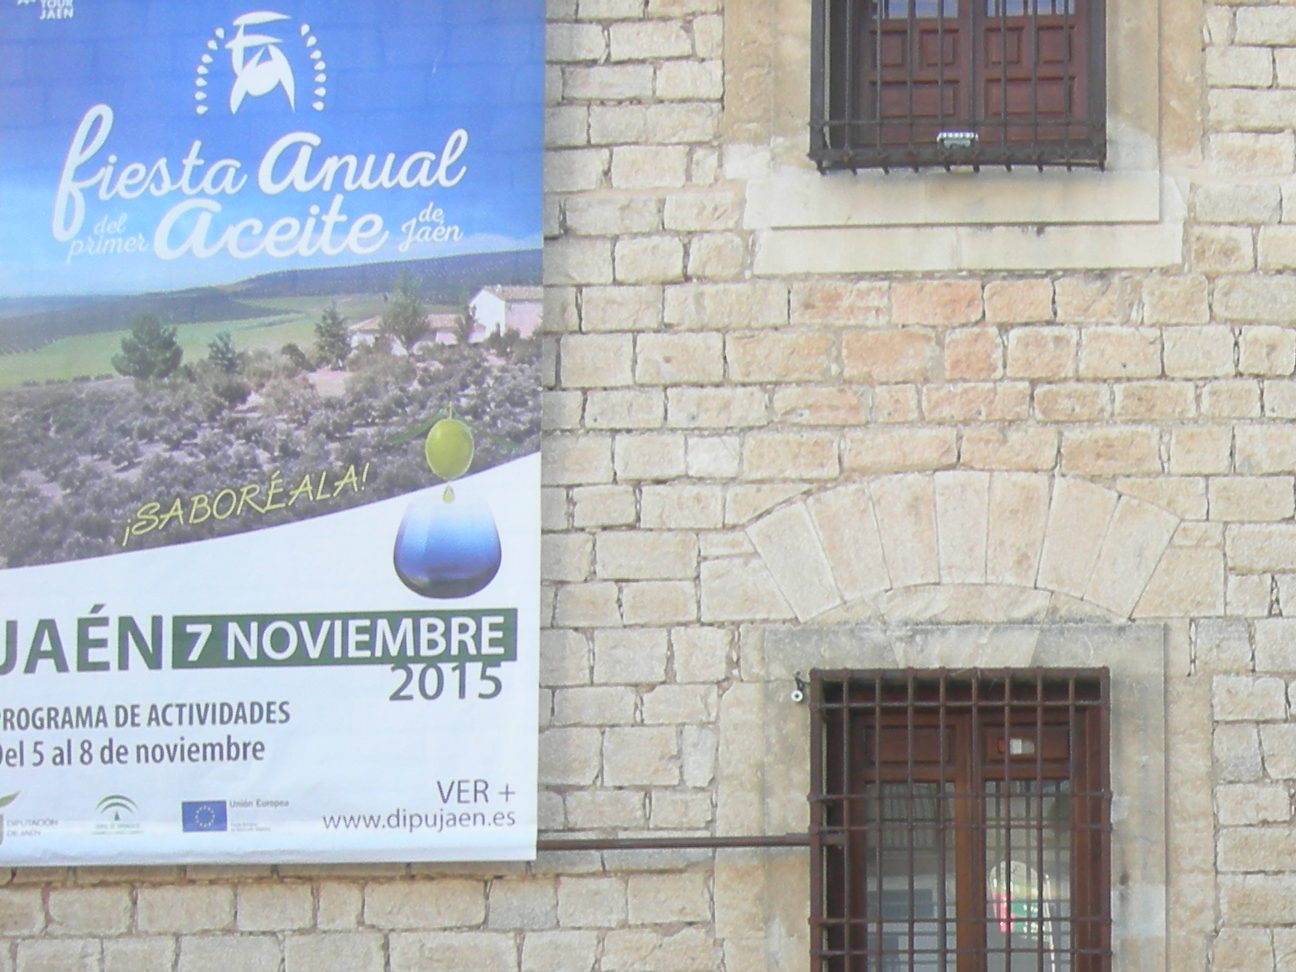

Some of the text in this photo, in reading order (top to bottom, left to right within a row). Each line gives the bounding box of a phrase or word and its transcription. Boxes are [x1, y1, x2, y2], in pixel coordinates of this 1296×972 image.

[257, 128, 469, 196] Anual
[93, 212, 128, 236] del
[153, 194, 389, 261] Aceite
[418, 201, 446, 224] de
[66, 232, 150, 264] primer
[121, 462, 371, 548] ¡SABORÉALA!
[0, 603, 506, 677] JAÉN 7 NOVIEMBRE
[388, 661, 503, 702] 2015
[0, 700, 291, 731] ROGRAMA DE ACTIVIDADES
[0, 734, 266, 768] el 5 al 8 de noviembre
[229, 797, 290, 808] Unión Europea
[436, 778, 490, 804] VER
[322, 807, 517, 834] www.dipujaen.es
